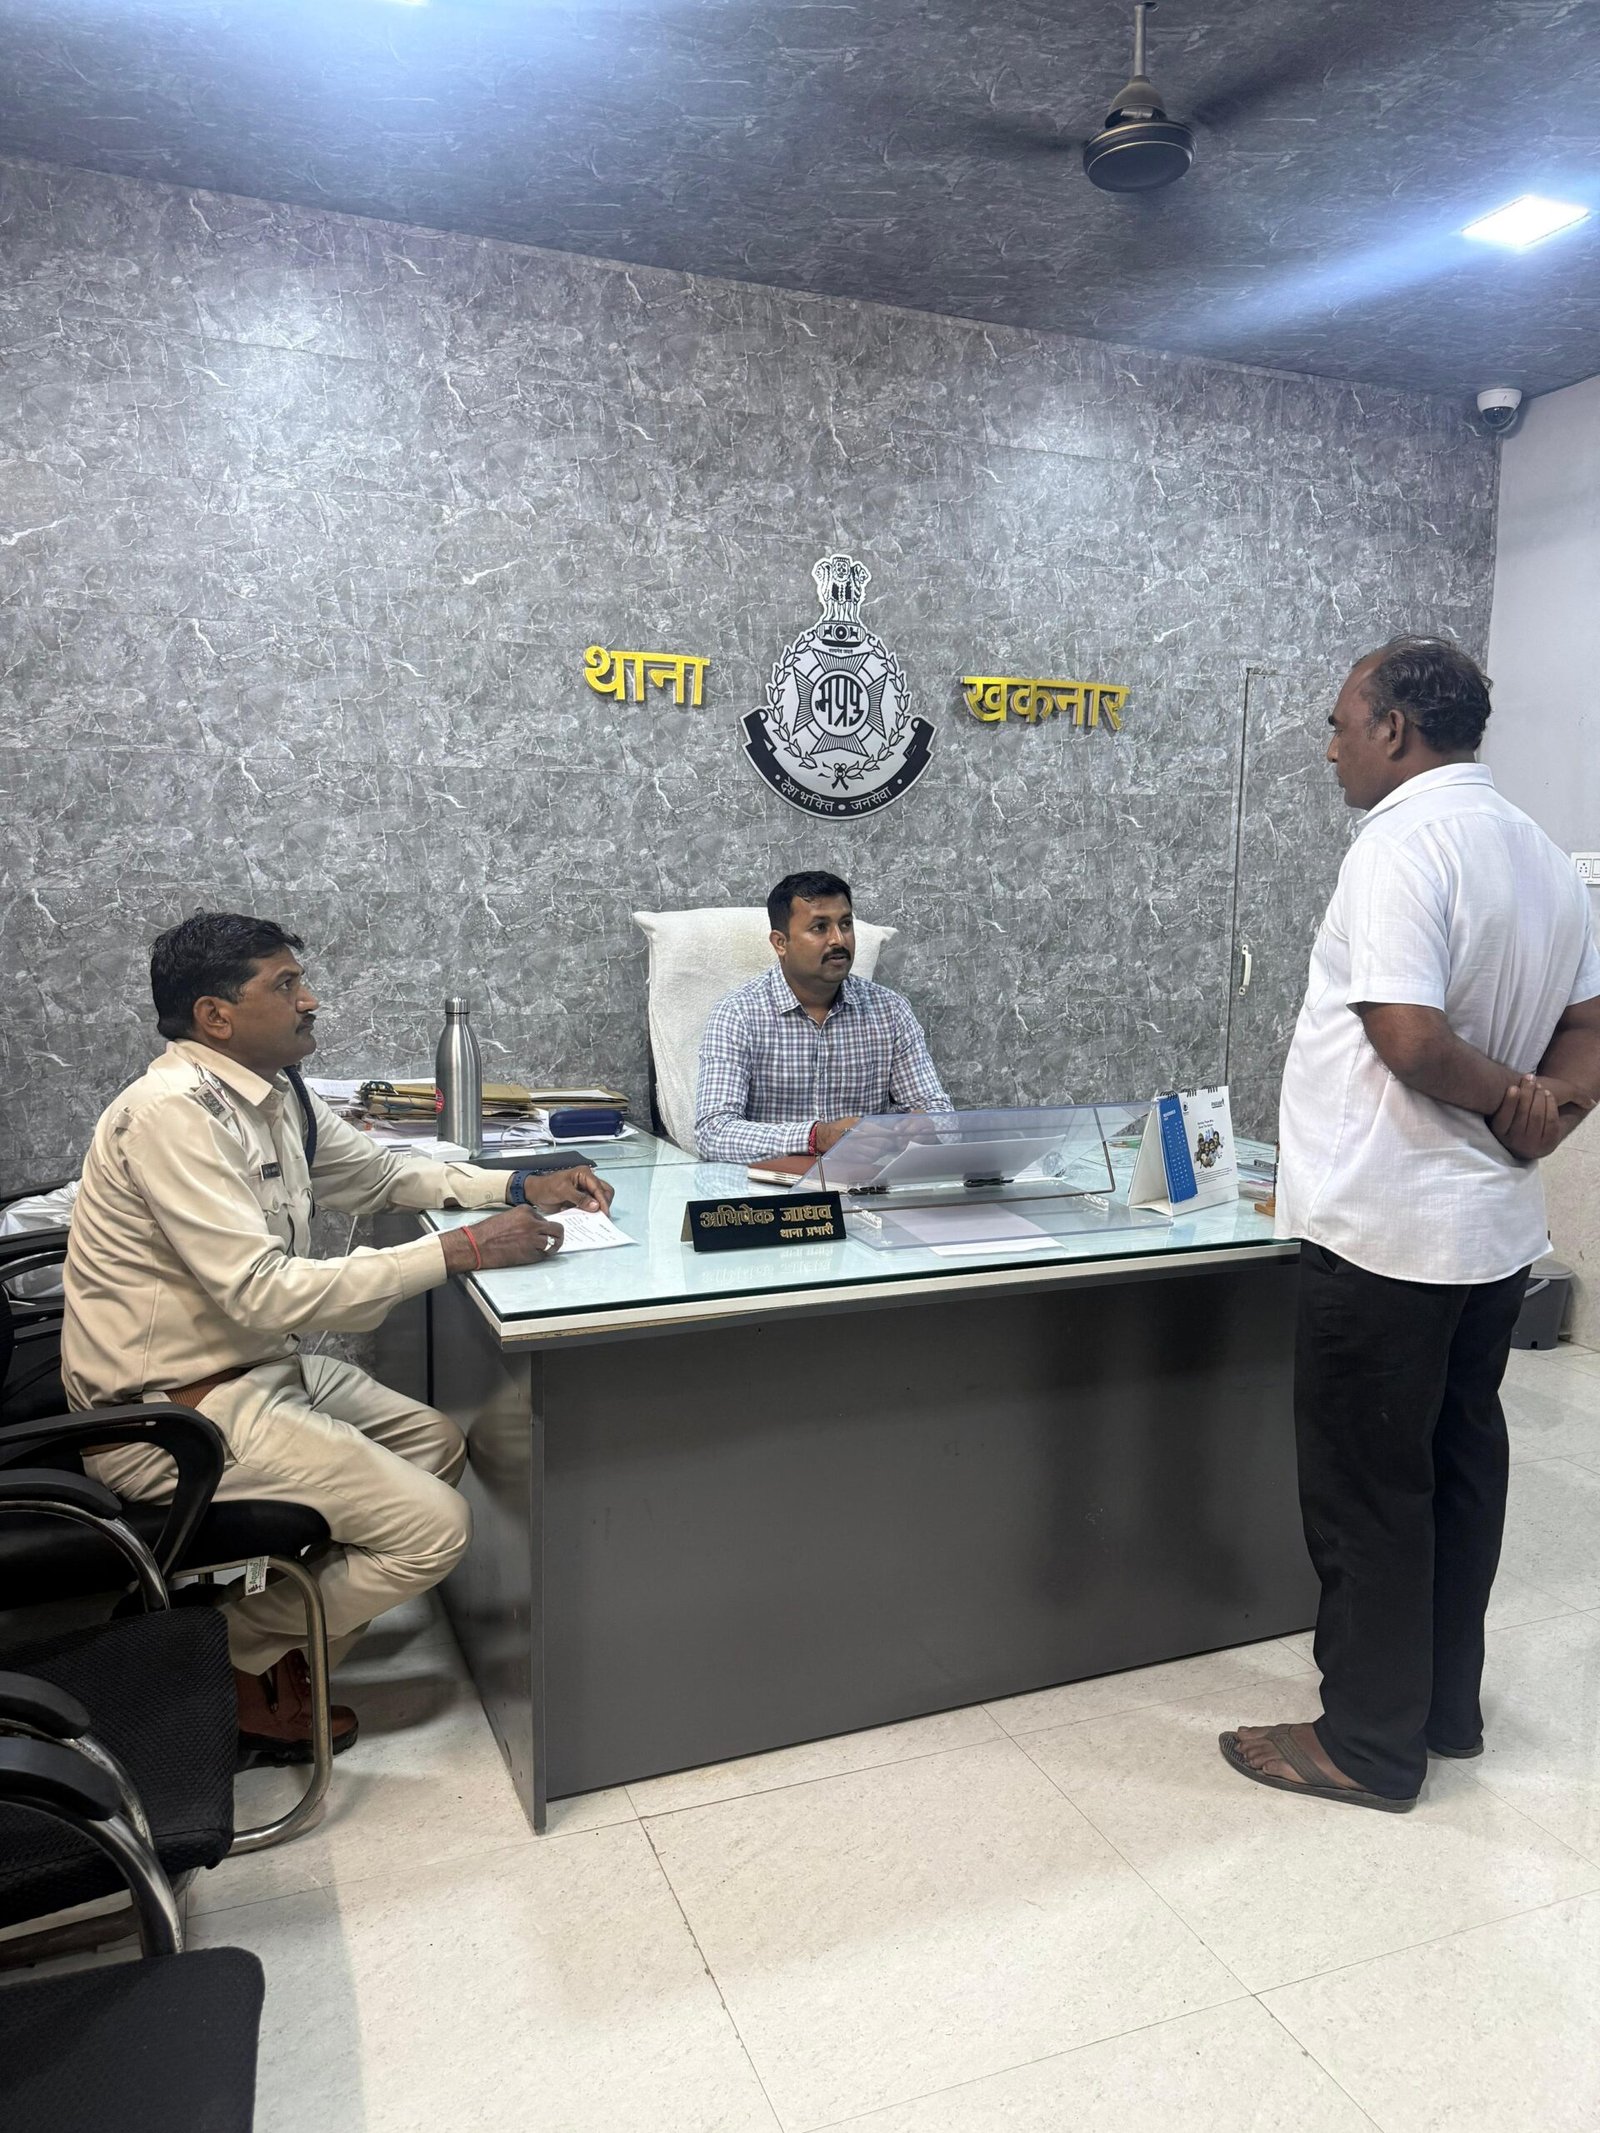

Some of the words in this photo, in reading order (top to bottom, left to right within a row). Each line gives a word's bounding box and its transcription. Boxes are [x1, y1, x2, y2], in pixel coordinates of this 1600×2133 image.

[584, 645, 710, 706] थाना
[960, 675, 1130, 731] खकनार
[850, 786, 892, 810] जनसेवा
[700, 1203, 775, 1228] अभिषेक
[780, 1204, 833, 1222] जाधव
[780, 1227, 803, 1239] थाना
[806, 1222, 834, 1237] प्रभारी
